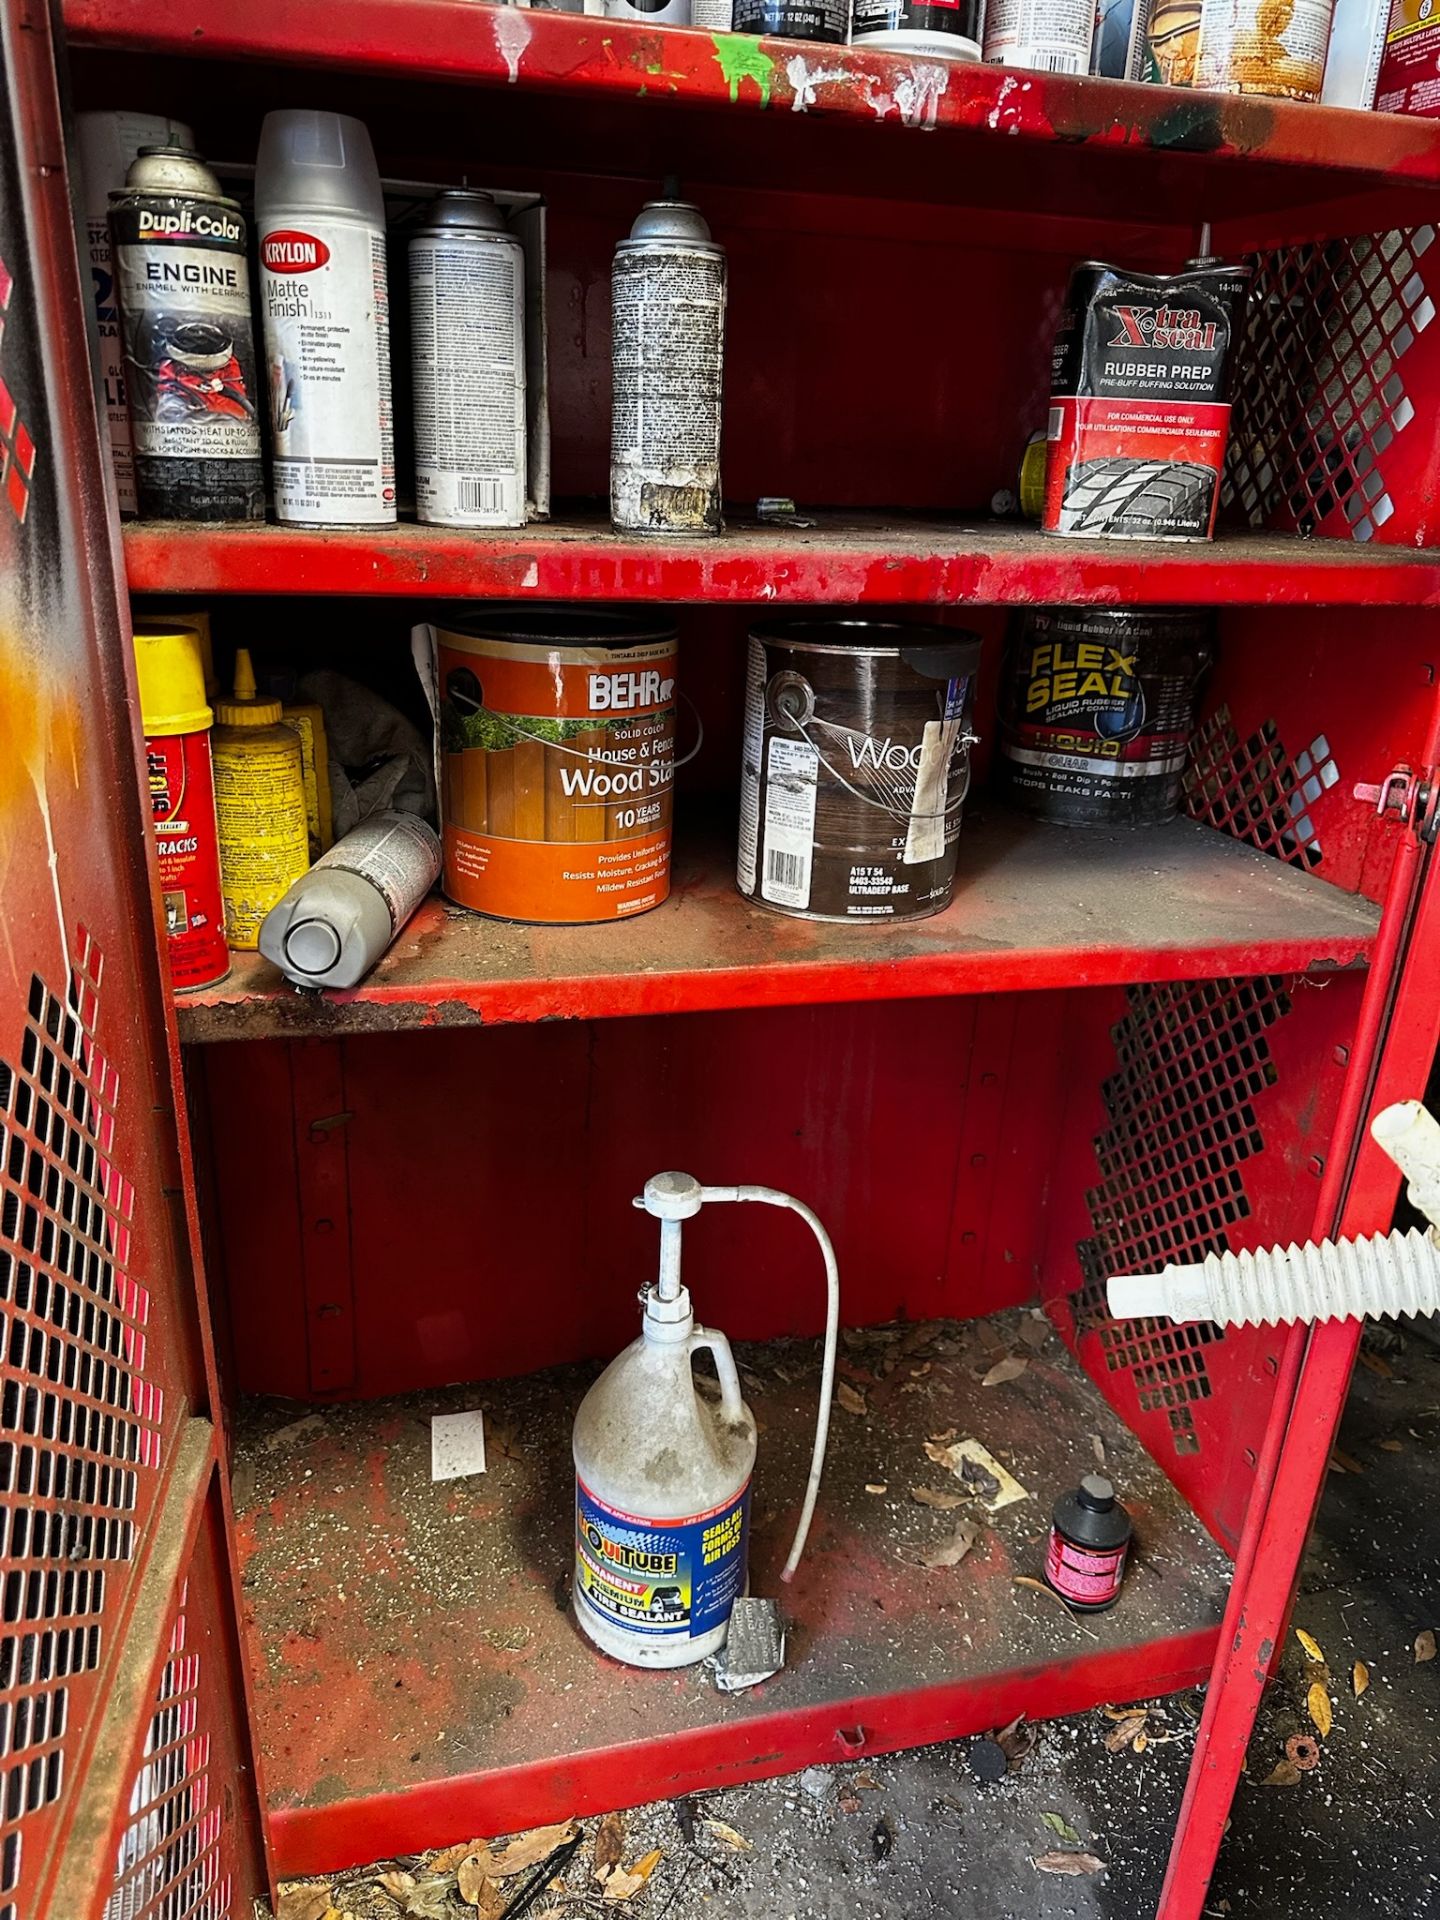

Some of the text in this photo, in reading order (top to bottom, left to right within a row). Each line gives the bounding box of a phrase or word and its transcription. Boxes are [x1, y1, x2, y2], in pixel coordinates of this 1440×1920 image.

[264, 242, 317, 264] KRYLON
[146, 262, 238, 287] ENGINE
[136, 282, 177, 292] ENAMEL
[181, 285, 208, 294] WITH
[267, 279, 309, 298] Matte
[268, 297, 308, 318] Finish
[1152, 322, 1216, 351] seal
[1104, 362, 1212, 380] RUBBER PREP
[1099, 378, 1215, 392] PRE-BUFF BUFFING SOLUTION
[1107, 412, 1121, 421] FOR
[1121, 413, 1163, 423] COMMERCIAL
[1163, 415, 1177, 423] USE
[1082, 624, 1114, 635] Rubber
[1030, 643, 1137, 679] FLEX
[588, 670, 661, 711] BEHR
[1026, 671, 1131, 713] SEAL
[1046, 698, 1125, 715] LIQUID RUBBER
[614, 723, 665, 741] SOLID COLOR
[588, 736, 674, 764] House & Fence
[1034, 731, 1121, 757] LIQUID
[1048, 755, 1089, 771] CLEAR
[560, 763, 643, 797] Wood
[1076, 776, 1091, 785] Dip
[892, 786, 915, 795] ADVA
[1049, 783, 1090, 796] LEAKS
[1094, 790, 1132, 800] FAT!
[615, 809, 635, 829] 10
[635, 801, 661, 817] YEARS
[156, 837, 198, 856] RACKS
[598, 851, 632, 865] Provides
[632, 845, 656, 859] Uniform
[562, 870, 595, 881] Resists
[596, 880, 626, 893] Mildew
[626, 873, 654, 889] Resistant
[849, 884, 910, 895] ULTRADEEP BASE
[702, 1505, 743, 1542] SEALS ALL
[702, 1526, 733, 1555] FORMS
[703, 1532, 741, 1566] AIR LOSS
[579, 1543, 641, 1595] PERMANENT
[590, 1573, 646, 1608] PREMIUM
[592, 1588, 685, 1622] TIRE SEALANT
